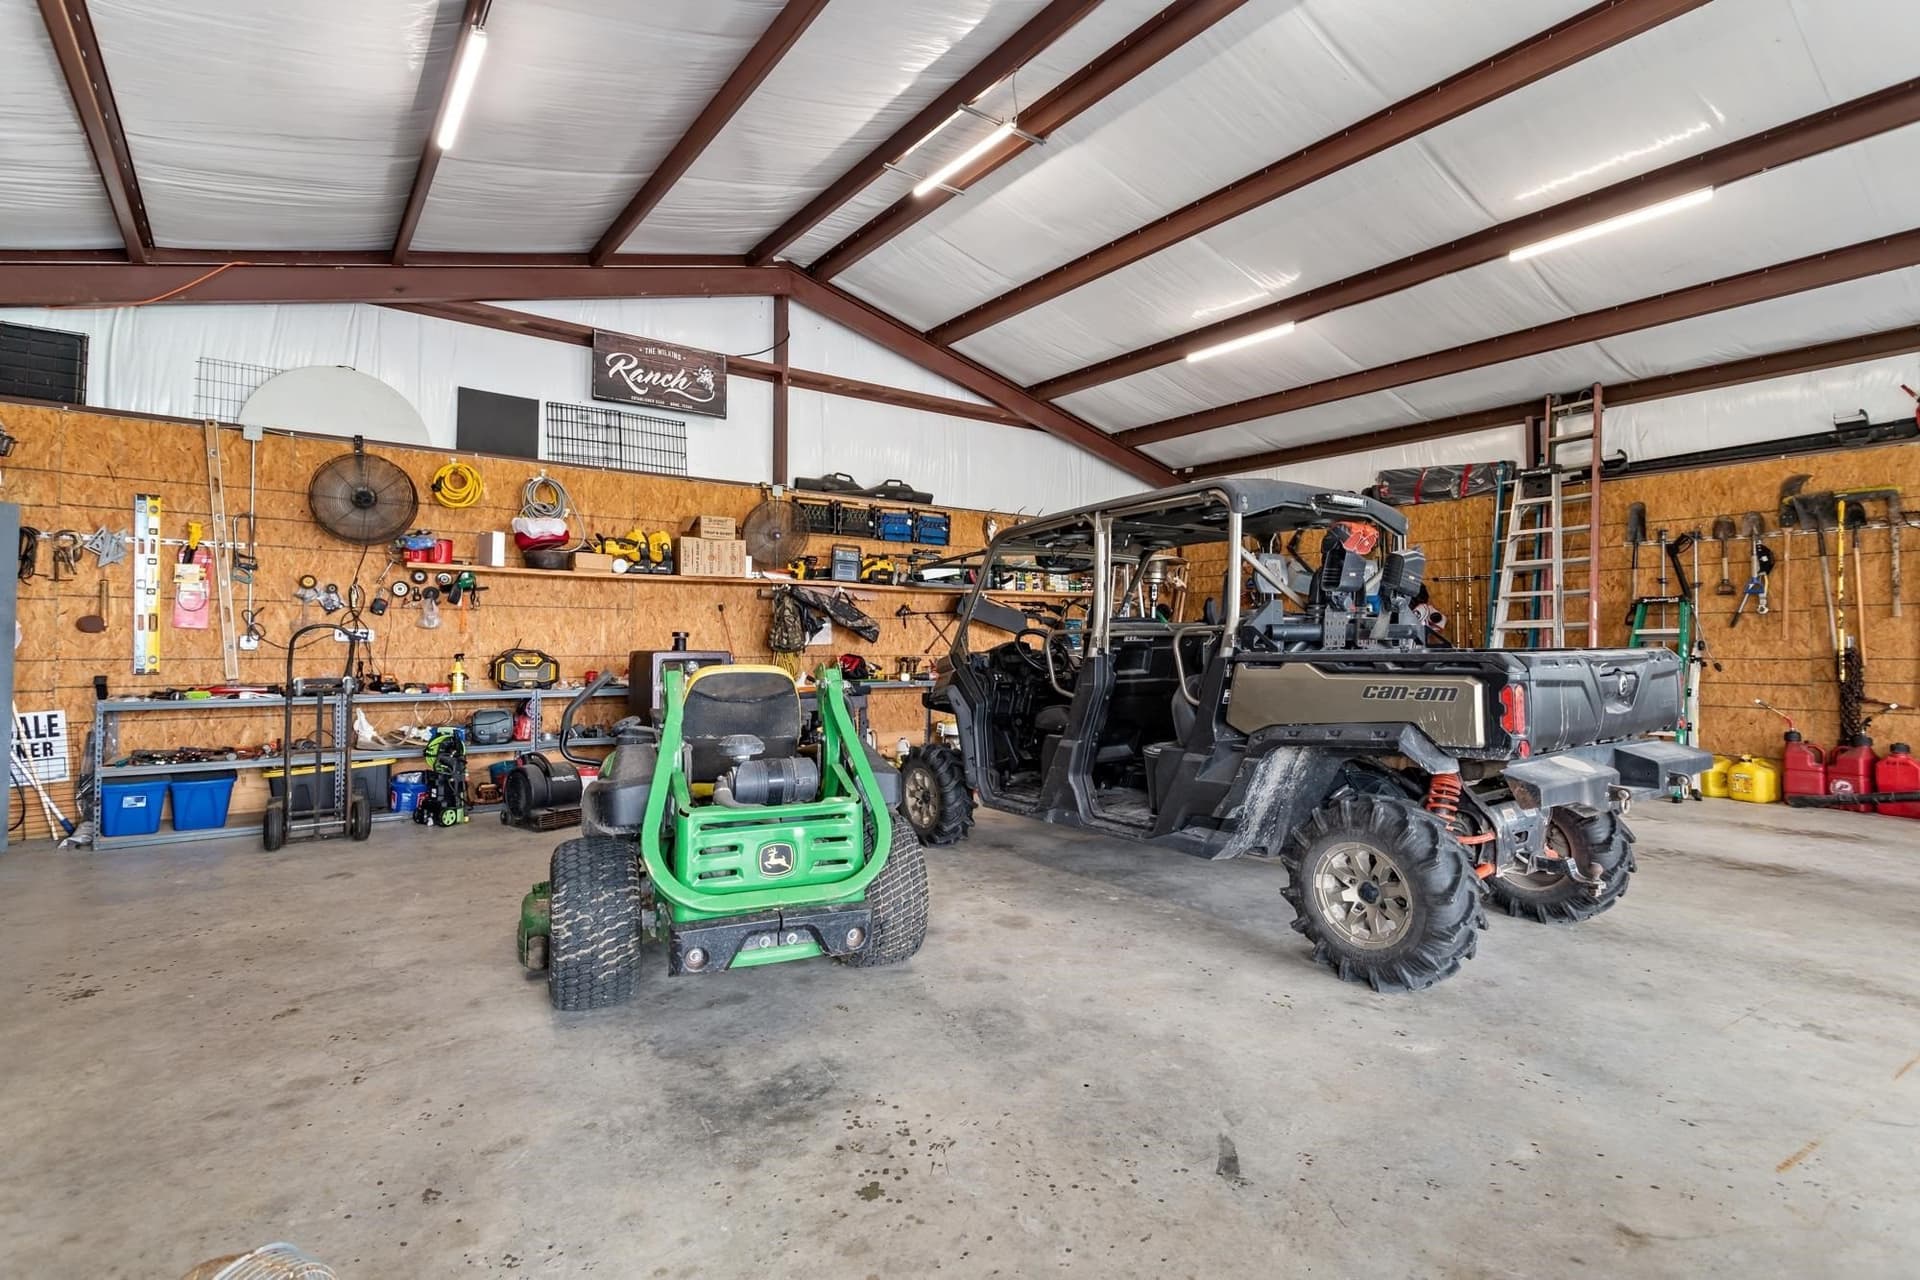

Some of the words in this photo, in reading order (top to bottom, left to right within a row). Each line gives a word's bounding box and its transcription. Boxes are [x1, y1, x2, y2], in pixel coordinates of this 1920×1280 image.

[645, 347, 656, 355] THE
[605, 352, 704, 399] Ranch
[1361, 685, 1459, 702] can-am
[11, 714, 60, 740] ALE
